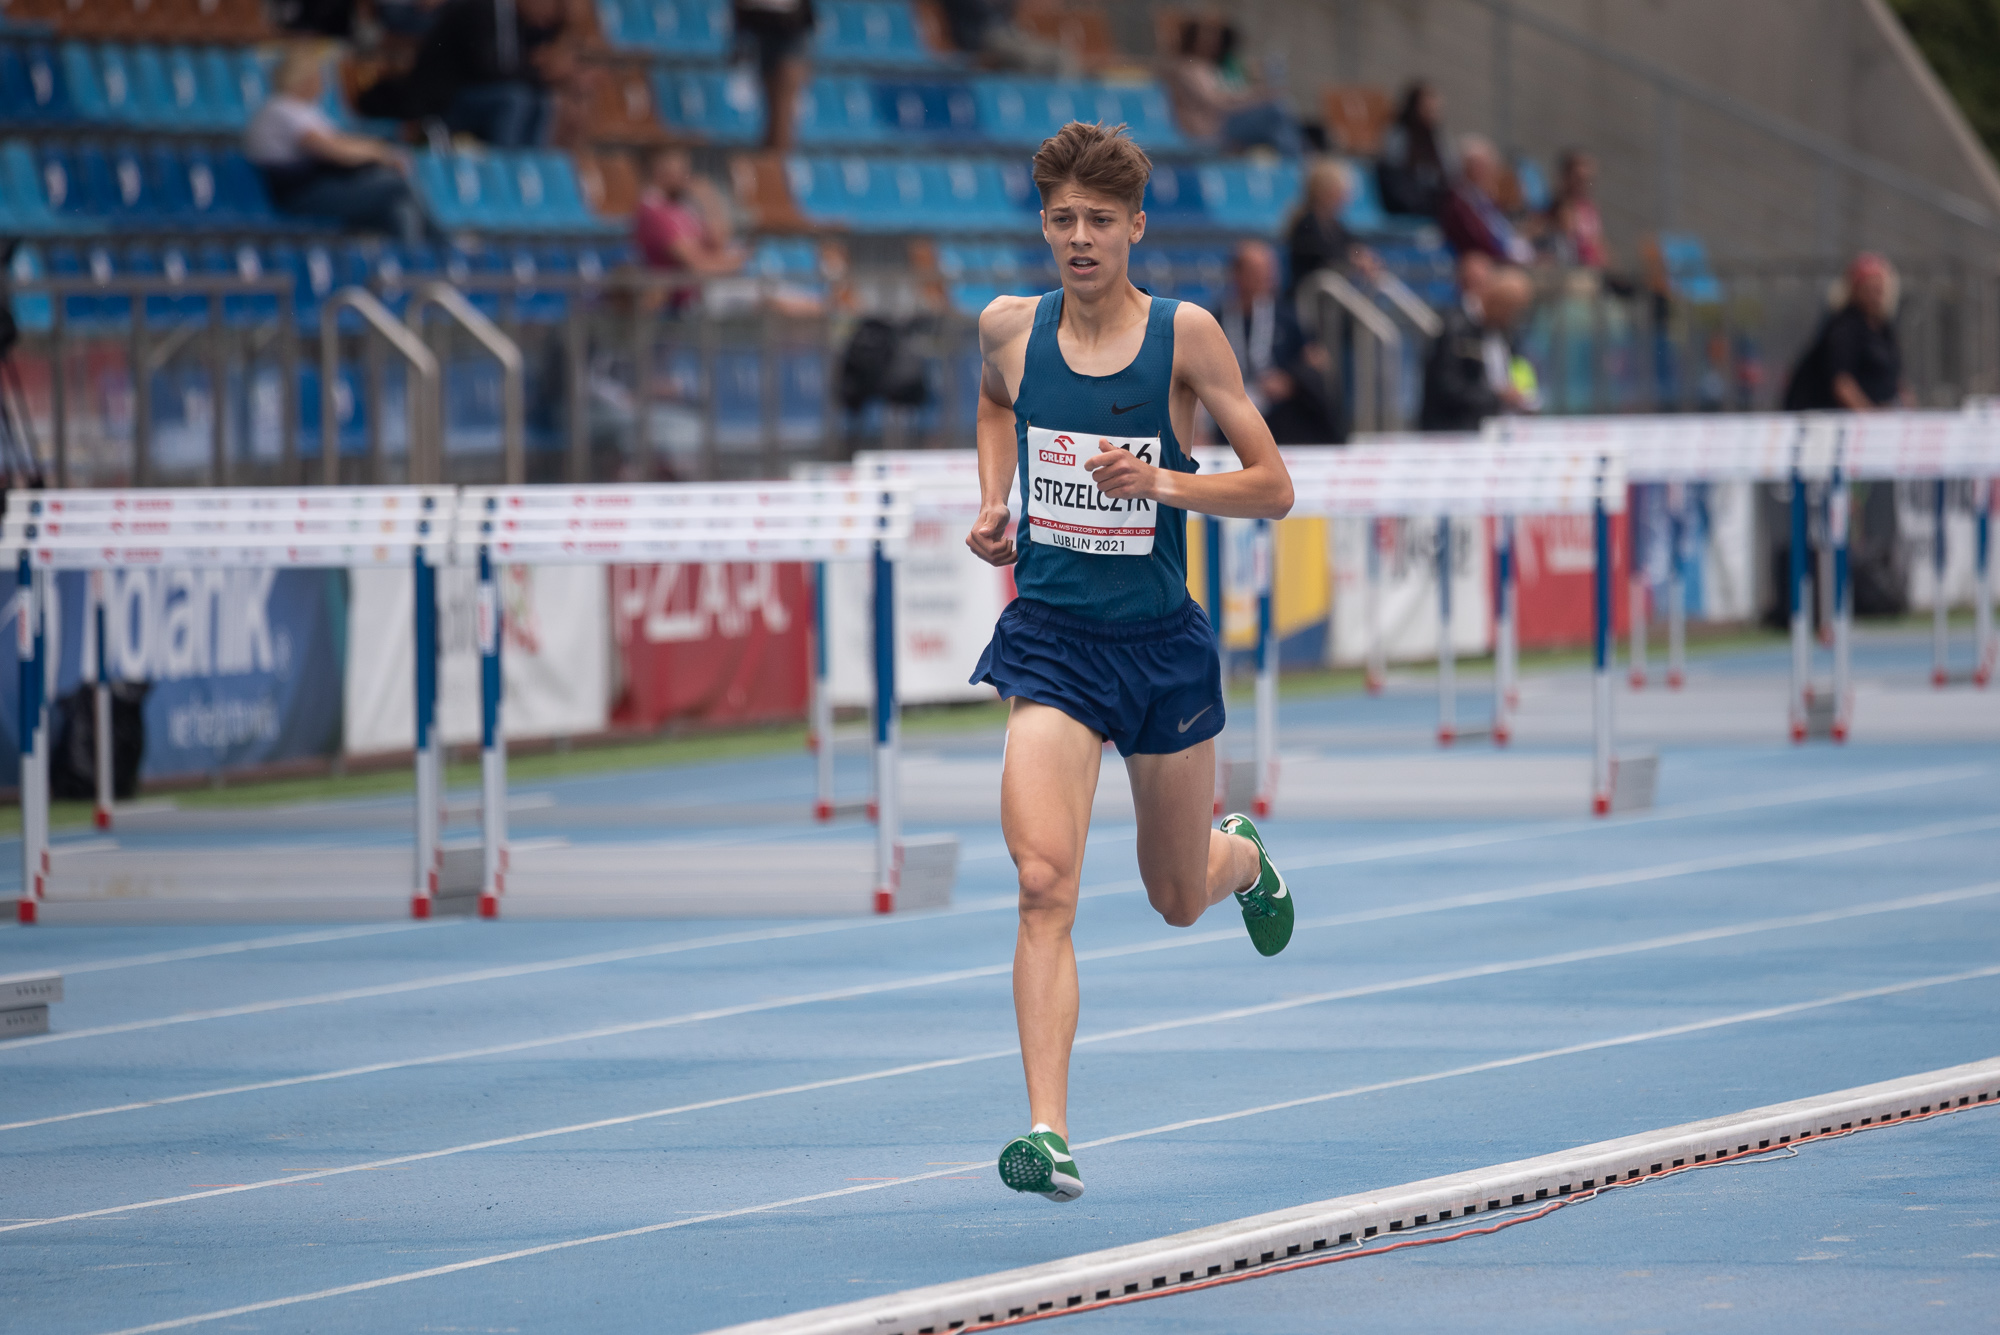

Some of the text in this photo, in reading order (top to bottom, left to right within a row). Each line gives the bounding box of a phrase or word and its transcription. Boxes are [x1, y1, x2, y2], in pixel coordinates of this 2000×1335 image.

[1040, 452, 1074, 465] ORLEN
[1042, 520, 1057, 528] PZLA
[1058, 523, 1107, 535] MISTRZOSTWA
[1052, 533, 1124, 552] LUBLIN 2021
